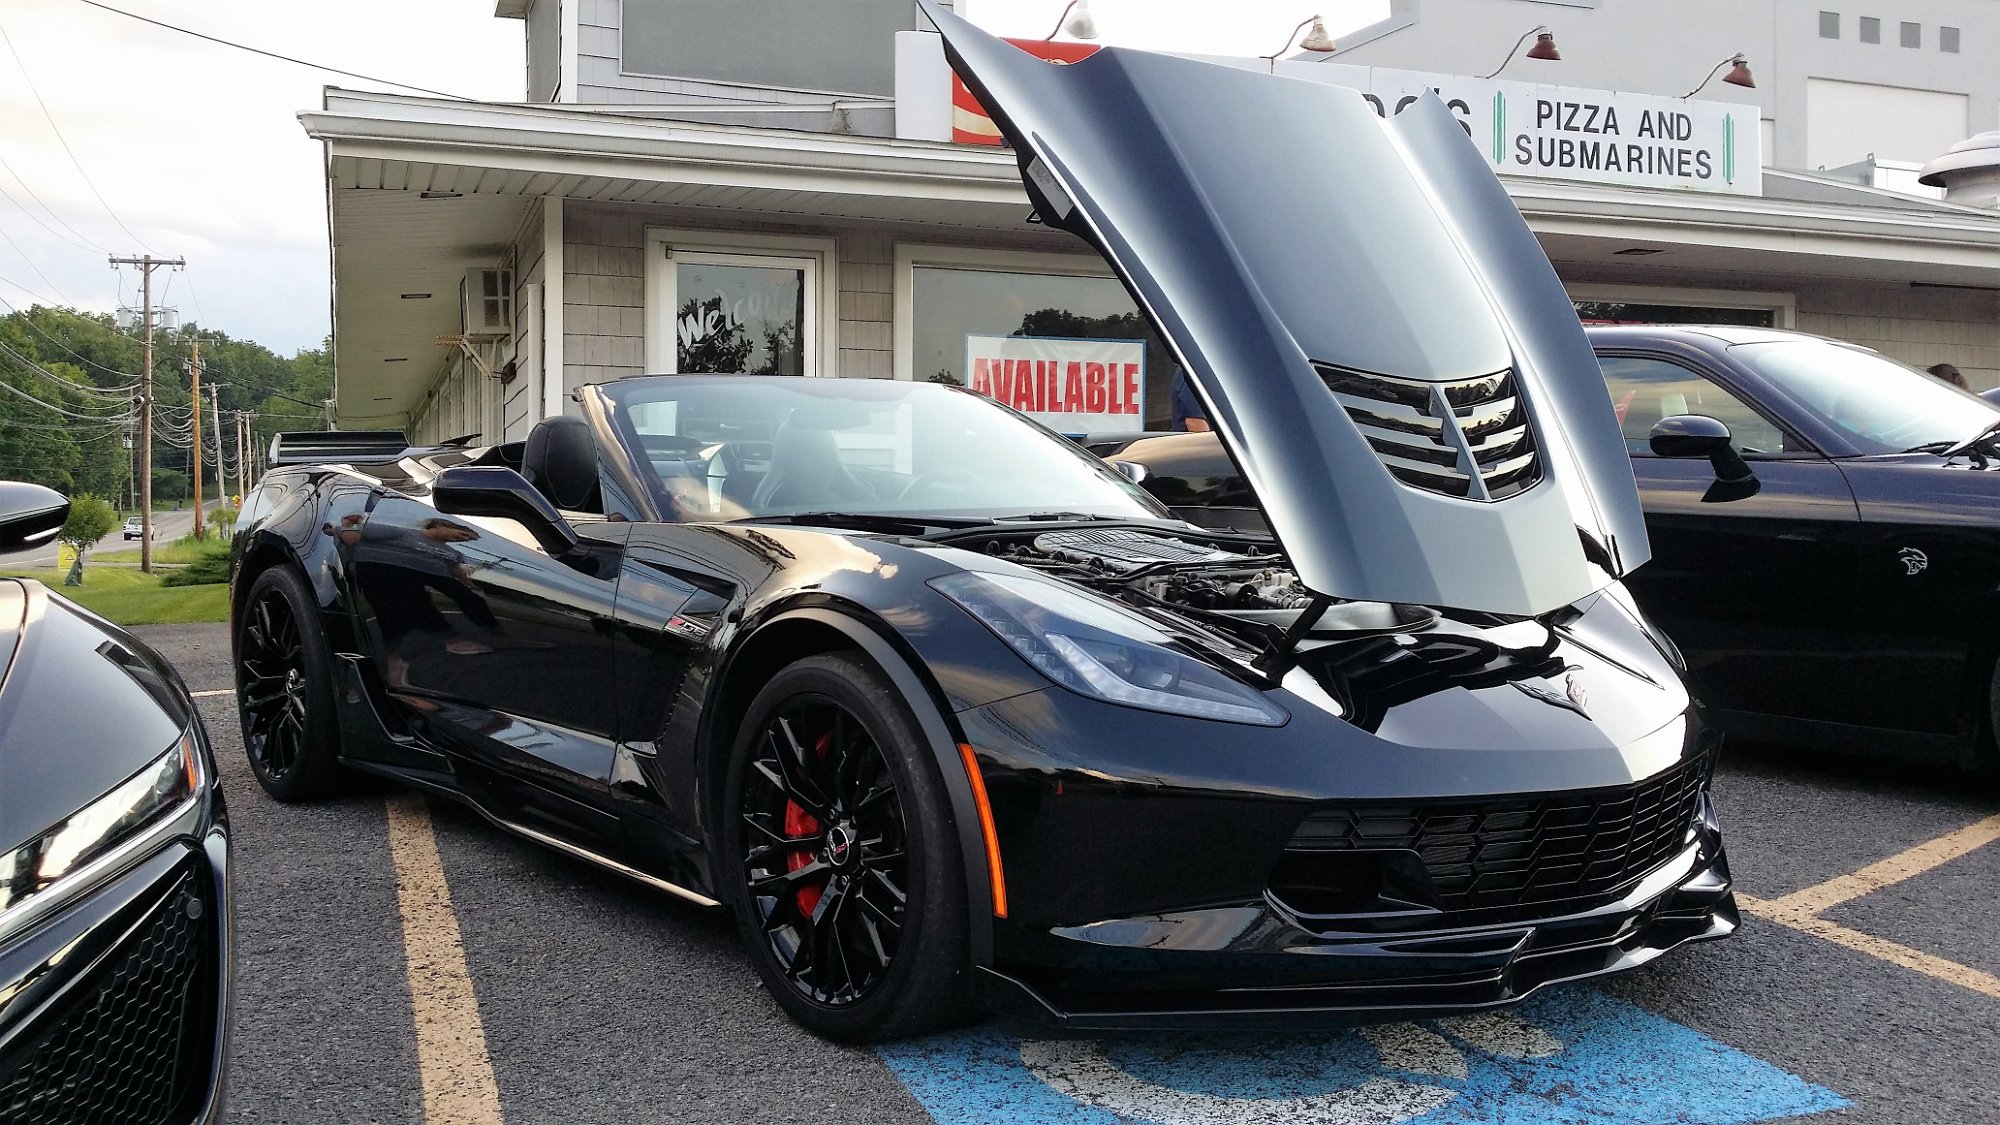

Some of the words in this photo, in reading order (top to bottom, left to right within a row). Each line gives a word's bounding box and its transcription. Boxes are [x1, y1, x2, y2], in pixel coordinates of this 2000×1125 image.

[1537, 100, 1620, 136] PIZZA
[1638, 110, 1692, 141] AND
[1515, 134, 1712, 179] SUBMARINES
[973, 358, 1140, 415] AVAILABLE
